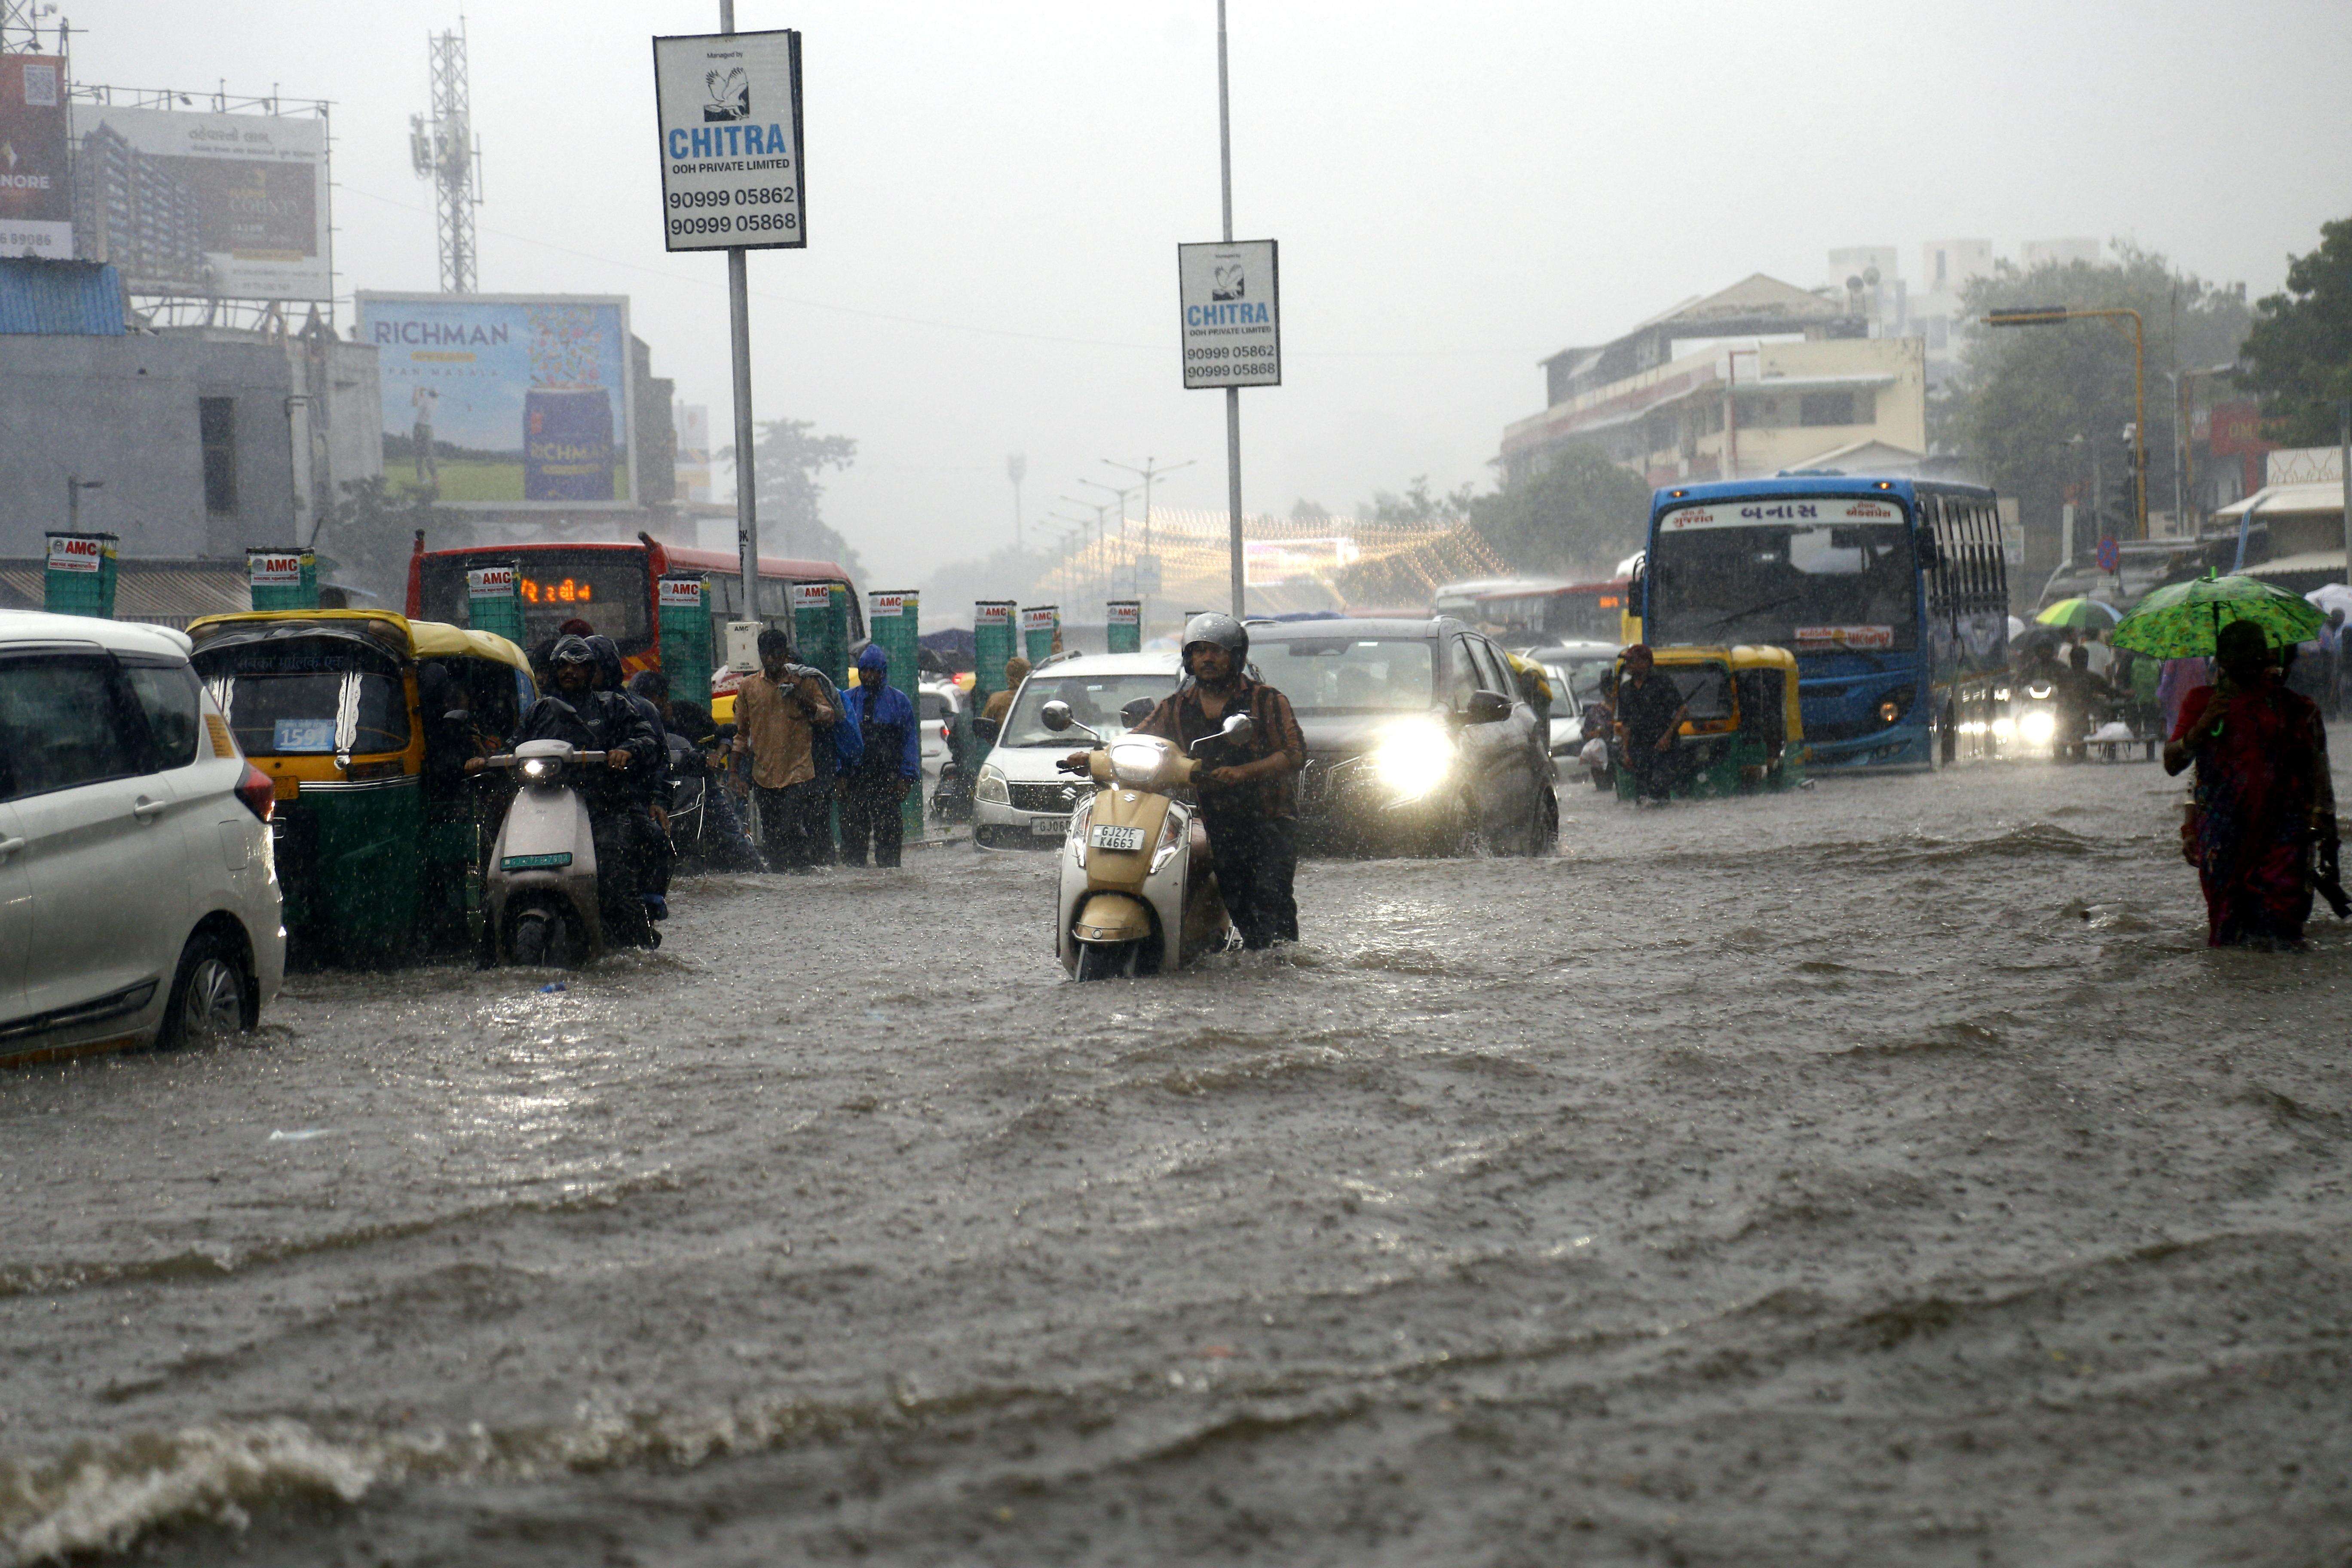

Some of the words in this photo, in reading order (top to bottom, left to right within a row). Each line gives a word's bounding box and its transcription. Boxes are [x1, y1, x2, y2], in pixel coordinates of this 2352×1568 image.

[669, 123, 786, 159] CHITRA
[673, 164, 696, 174] OOH
[699, 161, 744, 173] PRIVATE
[747, 159, 789, 170] LIMITED
[670, 190, 730, 208] 90999
[735, 186, 795, 205] 05862
[671, 216, 731, 235] 90999
[736, 212, 796, 232] 05868
[1187, 302, 1269, 327] CHITRA
[374, 321, 509, 345] RICHMAN
[1208, 328, 1239, 336] PRIVATE
[1241, 326, 1271, 334] LIMITED
[1188, 347, 1229, 360] 90999
[1233, 345, 1275, 358] 05862
[1188, 365, 1230, 378] 90999
[1233, 363, 1276, 376] 05868
[65, 541, 97, 556] AMC
[266, 559, 297, 572] AMC
[483, 572, 511, 585] AMC
[672, 584, 698, 595] AMC
[805, 587, 828, 597] AMC
[880, 597, 901, 606] AMC
[986, 607, 1007, 616] AMC
[1033, 612, 1052, 621] AMC
[280, 729, 328, 746] 1591
[1102, 827, 1136, 839] GJ27F
[1100, 837, 1133, 848] K4663
